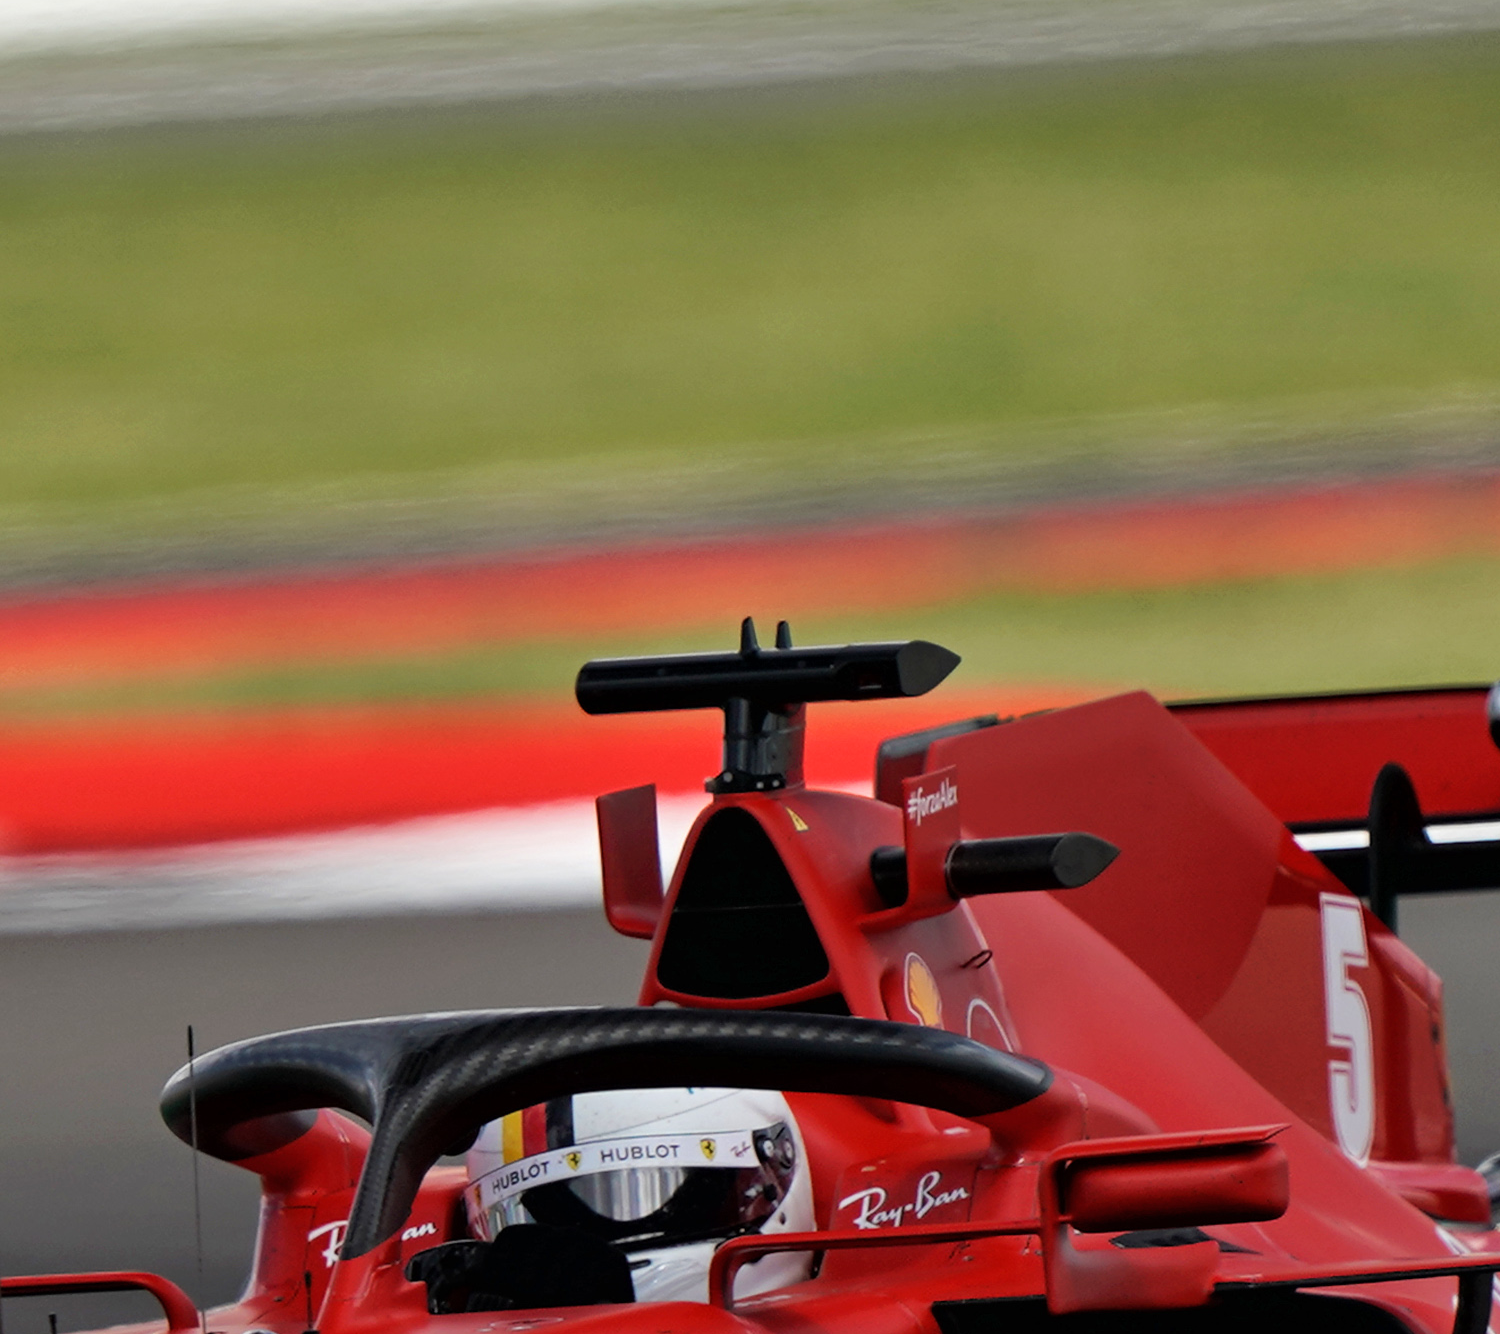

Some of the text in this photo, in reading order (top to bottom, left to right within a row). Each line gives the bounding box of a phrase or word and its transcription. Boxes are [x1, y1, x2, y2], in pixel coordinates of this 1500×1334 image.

[907, 777, 958, 827] #forzaAlex
[1319, 891, 1375, 1168] 5
[491, 1160, 550, 1195] HUBLOT
[601, 1144, 681, 1164] HUBLOT
[838, 1170, 970, 1230] Ray-Ban
